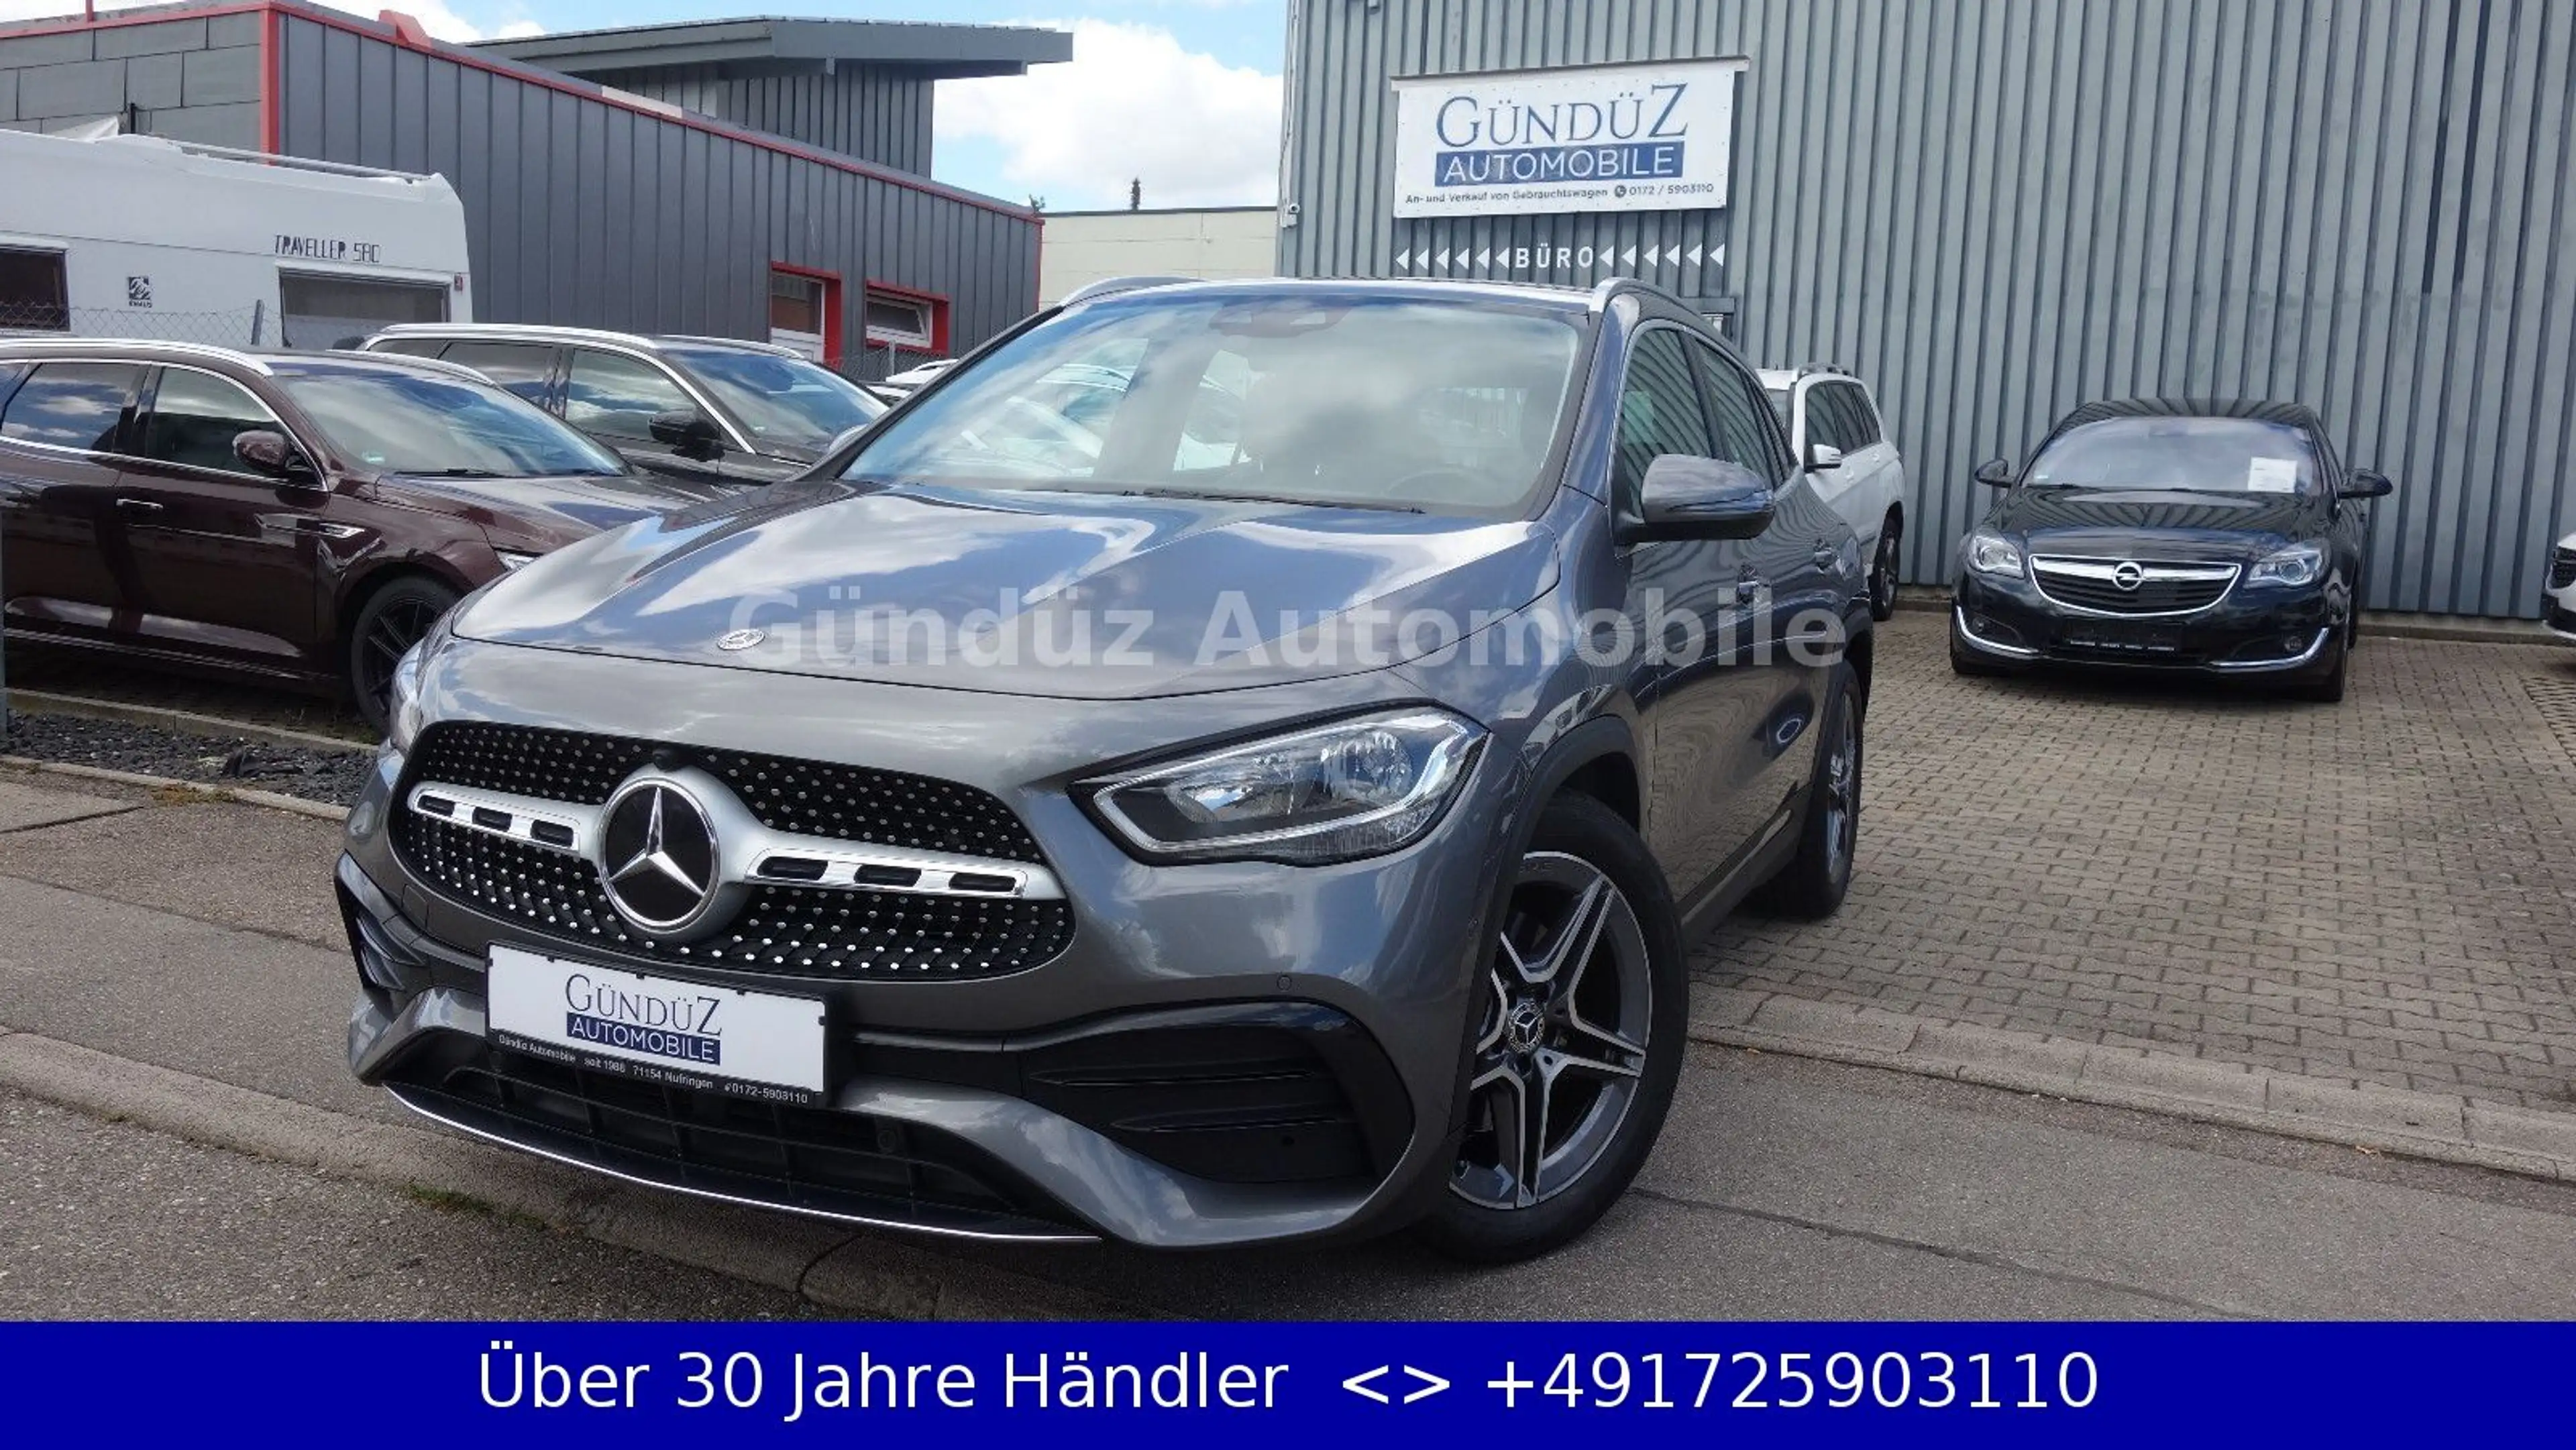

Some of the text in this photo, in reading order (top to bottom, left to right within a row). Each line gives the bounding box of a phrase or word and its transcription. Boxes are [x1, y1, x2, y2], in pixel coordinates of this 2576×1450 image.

[1436, 82, 1688, 147] GÜNDÜZ
[1442, 146, 1675, 183] AUTOMOBILE
[1405, 194, 1424, 204] An-
[1426, 192, 1445, 203] und
[1448, 191, 1488, 203] Verkauf
[1491, 192, 1509, 201] von
[1513, 186, 1609, 200] Gebrauchtswagen
[1629, 185, 1655, 196] 0172
[274, 235, 346, 260] TRAVELLER
[1515, 242, 1594, 269] BÜRO
[566, 973, 722, 1036] GÜNDÜZ
[571, 1017, 714, 1062] AUTOMOBILE
[529, 1042, 576, 1063] Automobile
[584, 1057, 601, 1068] seit
[633, 1065, 661, 1079] 71154
[665, 1072, 713, 1089] Nufringen
[732, 1082, 808, 1103] 0172-5903110
